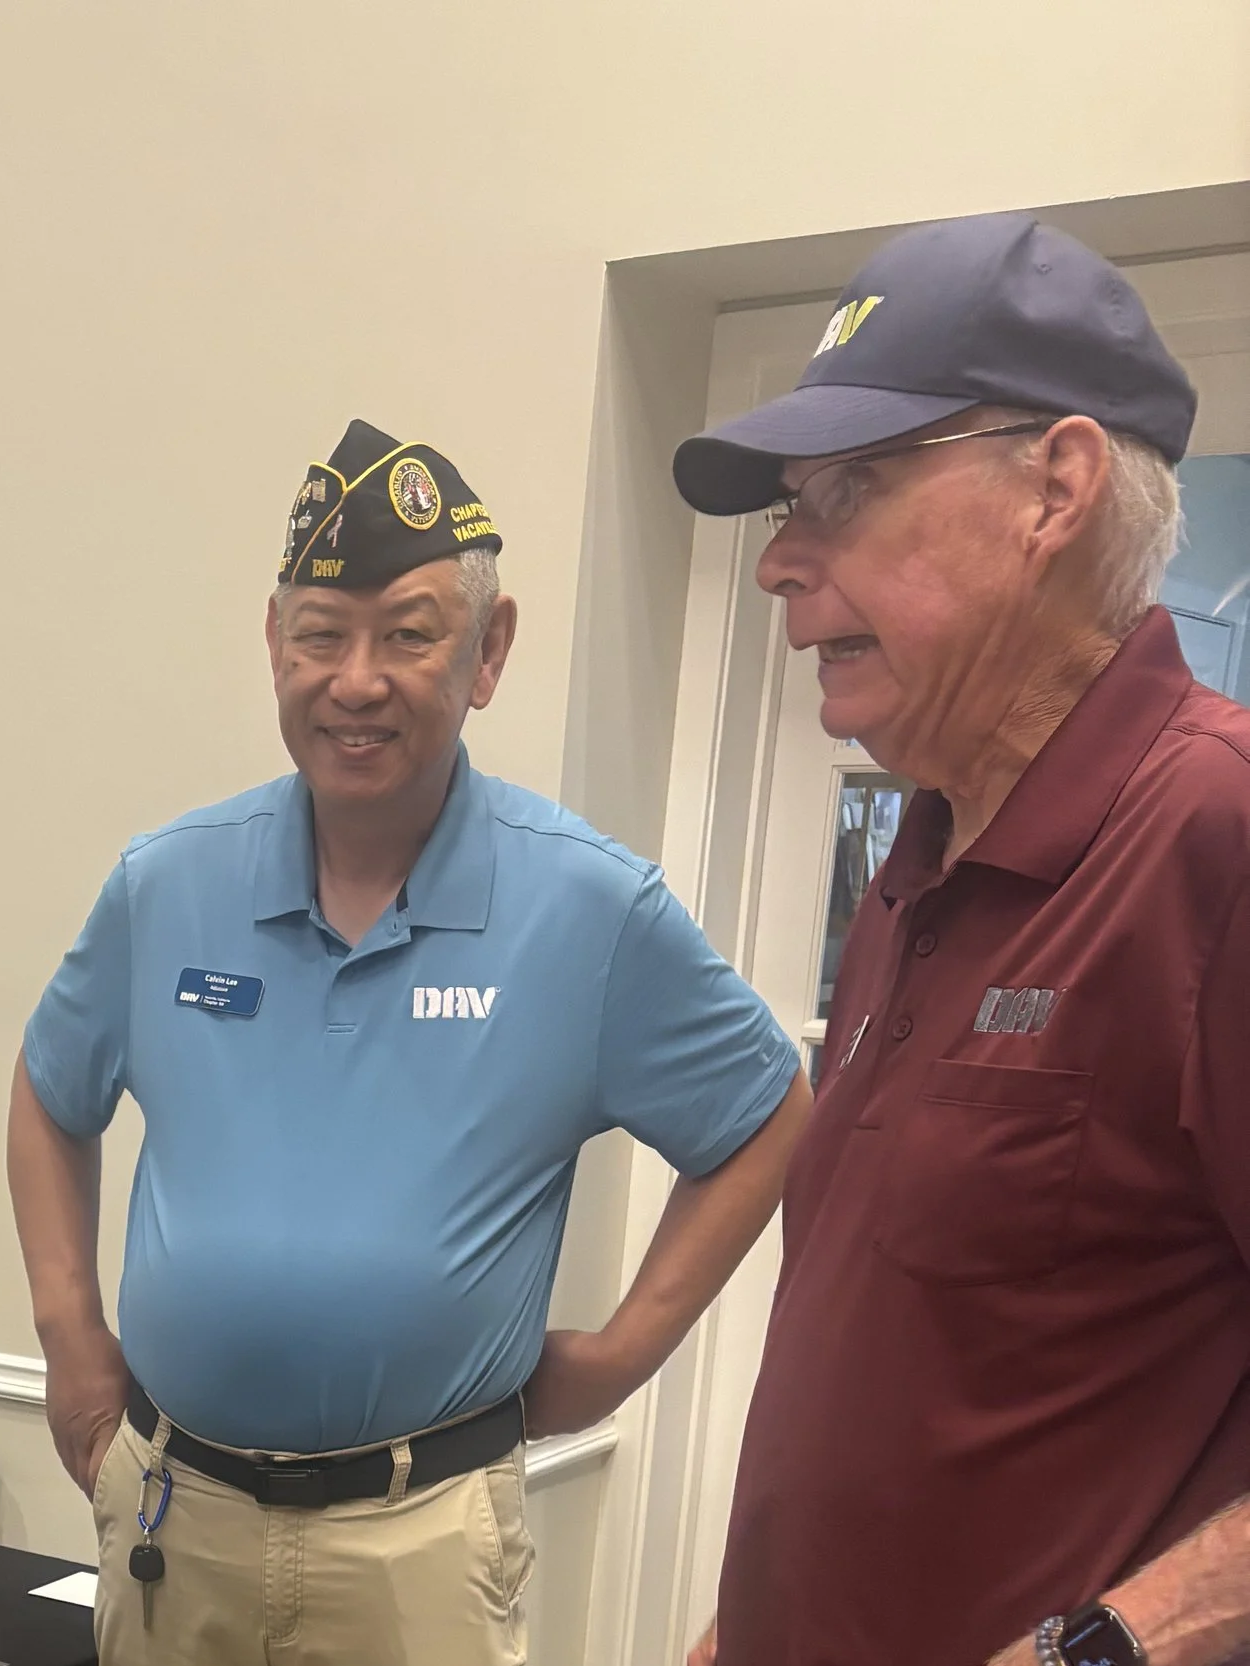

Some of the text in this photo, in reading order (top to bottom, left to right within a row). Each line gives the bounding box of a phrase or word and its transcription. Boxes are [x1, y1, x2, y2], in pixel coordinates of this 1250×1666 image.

[813, 296, 878, 358] AV
[312, 559, 342, 577] DAV
[180, 992, 200, 1002] DAV
[412, 987, 497, 1019] DAV
[974, 987, 1062, 1034] DAV
